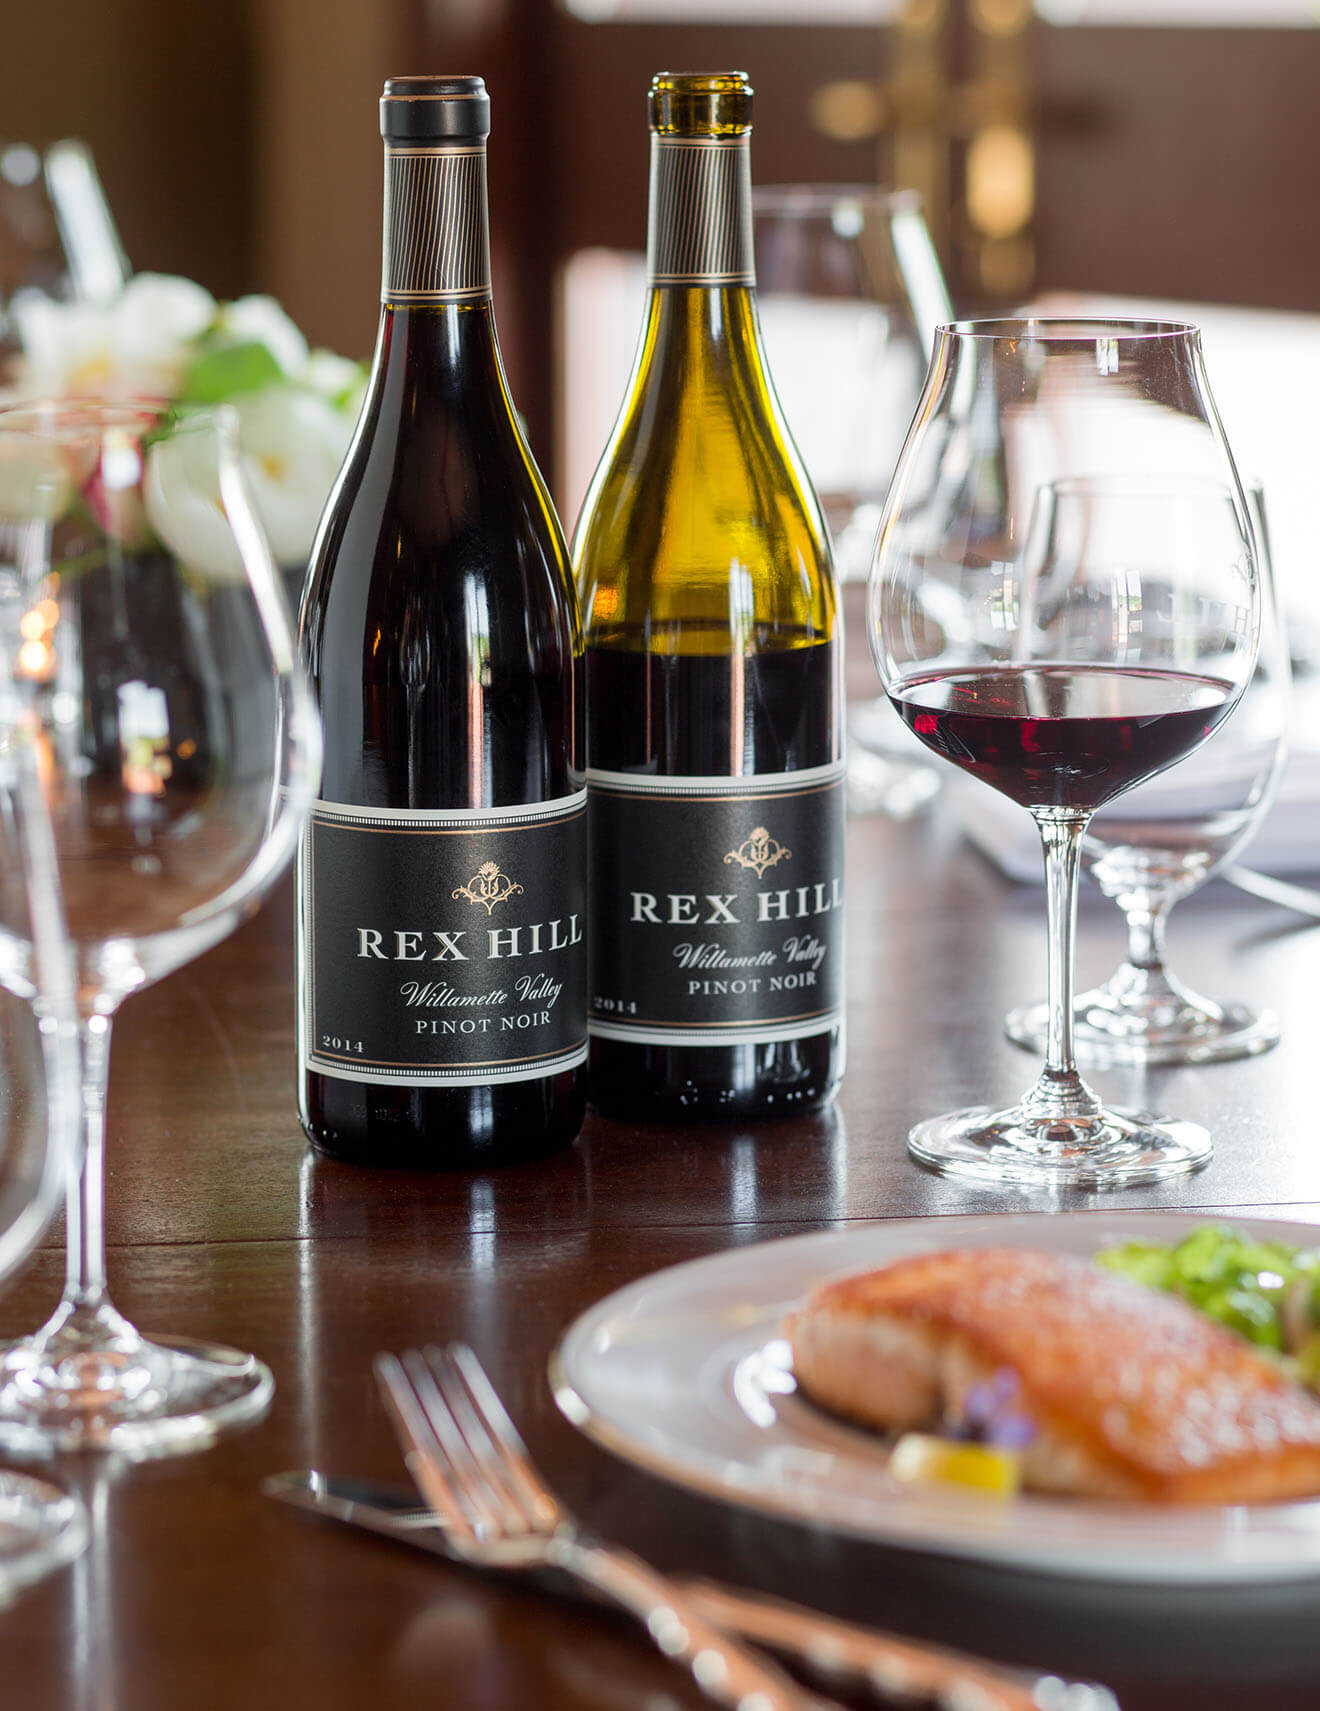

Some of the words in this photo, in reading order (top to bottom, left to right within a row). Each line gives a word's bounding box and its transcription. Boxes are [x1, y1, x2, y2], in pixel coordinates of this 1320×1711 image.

[631, 892, 740, 924] REX
[757, 878, 842, 922] HILL
[357, 927, 470, 960] REX
[487, 913, 583, 959] HILL
[673, 943, 777, 969] Willamette
[400, 981, 508, 1007] Willamette
[514, 973, 562, 1008] Valley
[688, 979, 761, 994] PINOT
[770, 971, 817, 990] NOIR
[415, 1019, 491, 1033] PINOT
[500, 1010, 551, 1031] NOIR
[322, 1035, 364, 1053] 2014
